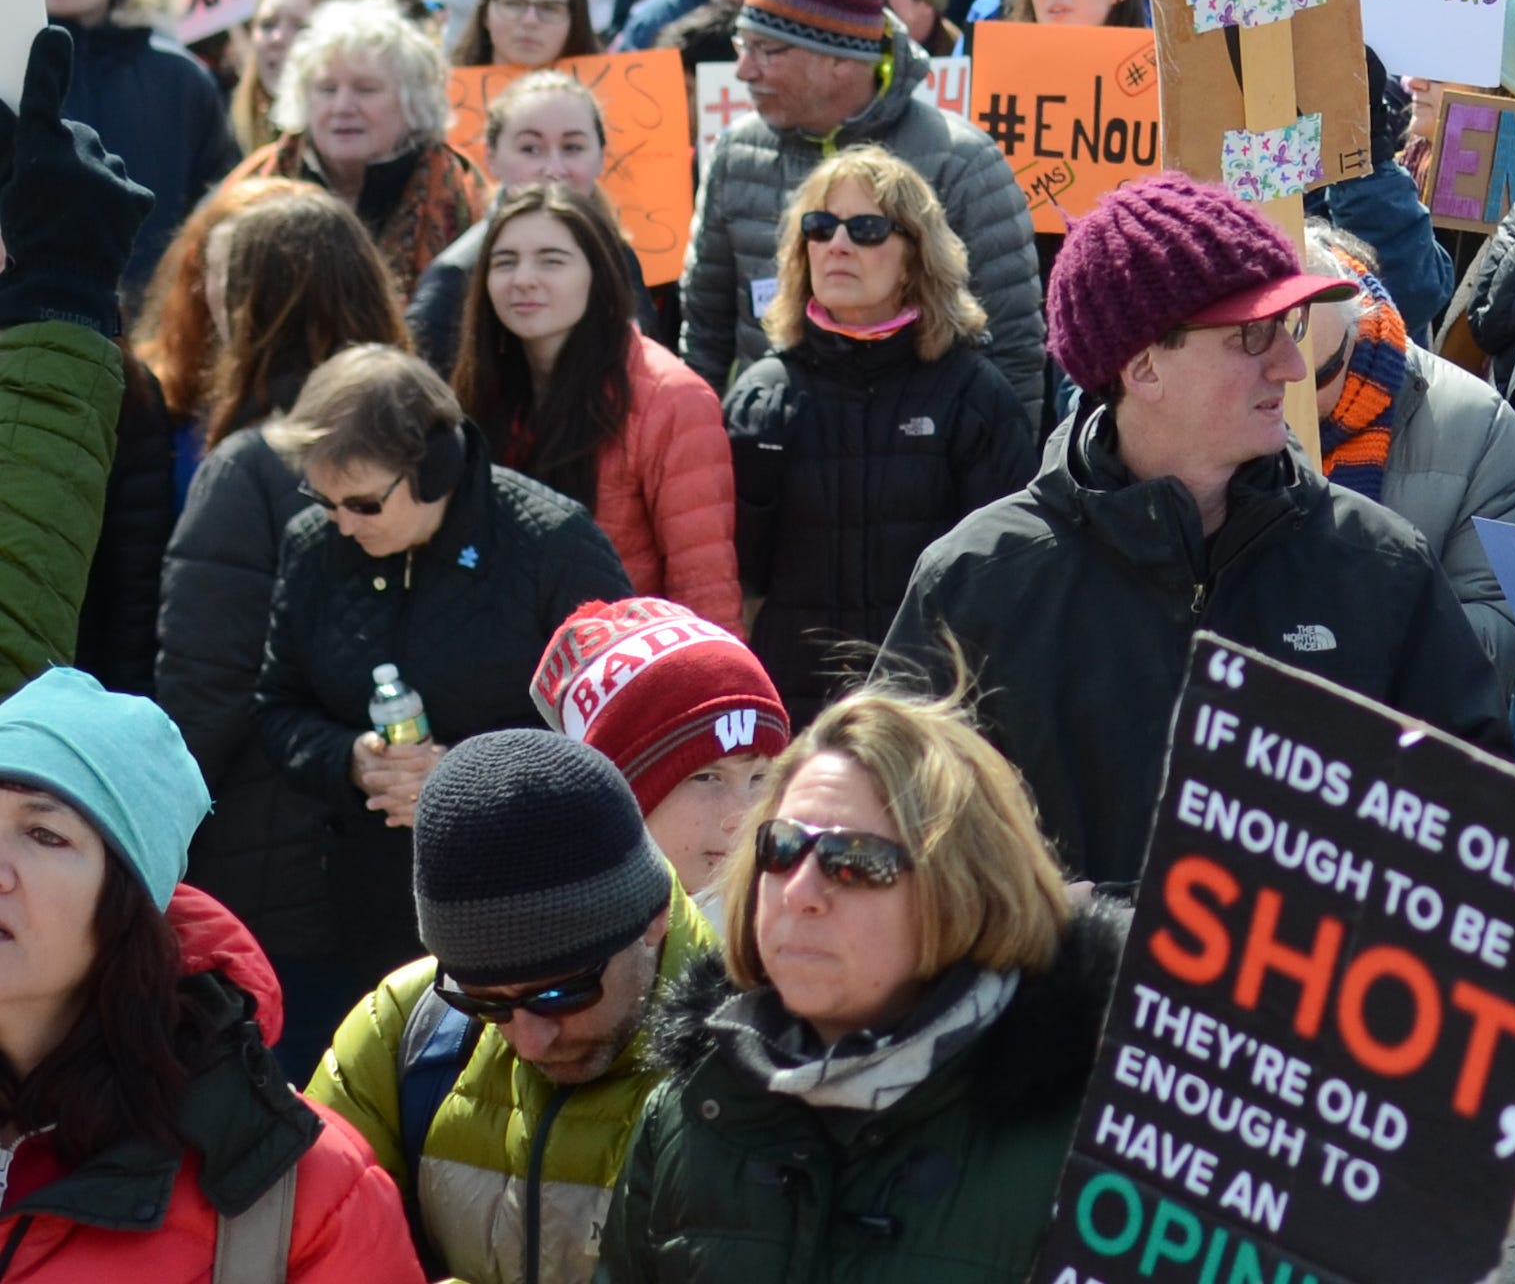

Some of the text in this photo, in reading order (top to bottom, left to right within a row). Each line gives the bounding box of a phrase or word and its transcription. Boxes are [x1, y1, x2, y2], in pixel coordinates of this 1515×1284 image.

[979, 76, 1158, 167] #ENOU
[1282, 633, 1315, 643] NORTH
[1294, 642, 1318, 651] FACE
[1297, 624, 1316, 634] THE
[714, 708, 757, 753] W
[1192, 704, 1240, 751] IF
[1244, 726, 1352, 806] KIDS
[1357, 780, 1452, 854] ARE
[1177, 780, 1515, 967] ENOUGH TO BE
[1114, 1046, 1380, 1202] ENOUGH TO
[1134, 983, 1408, 1151] THEY'RE OLD
[1096, 1104, 1290, 1234] HAVE AN
[1076, 1170, 1320, 1284] OPIN
